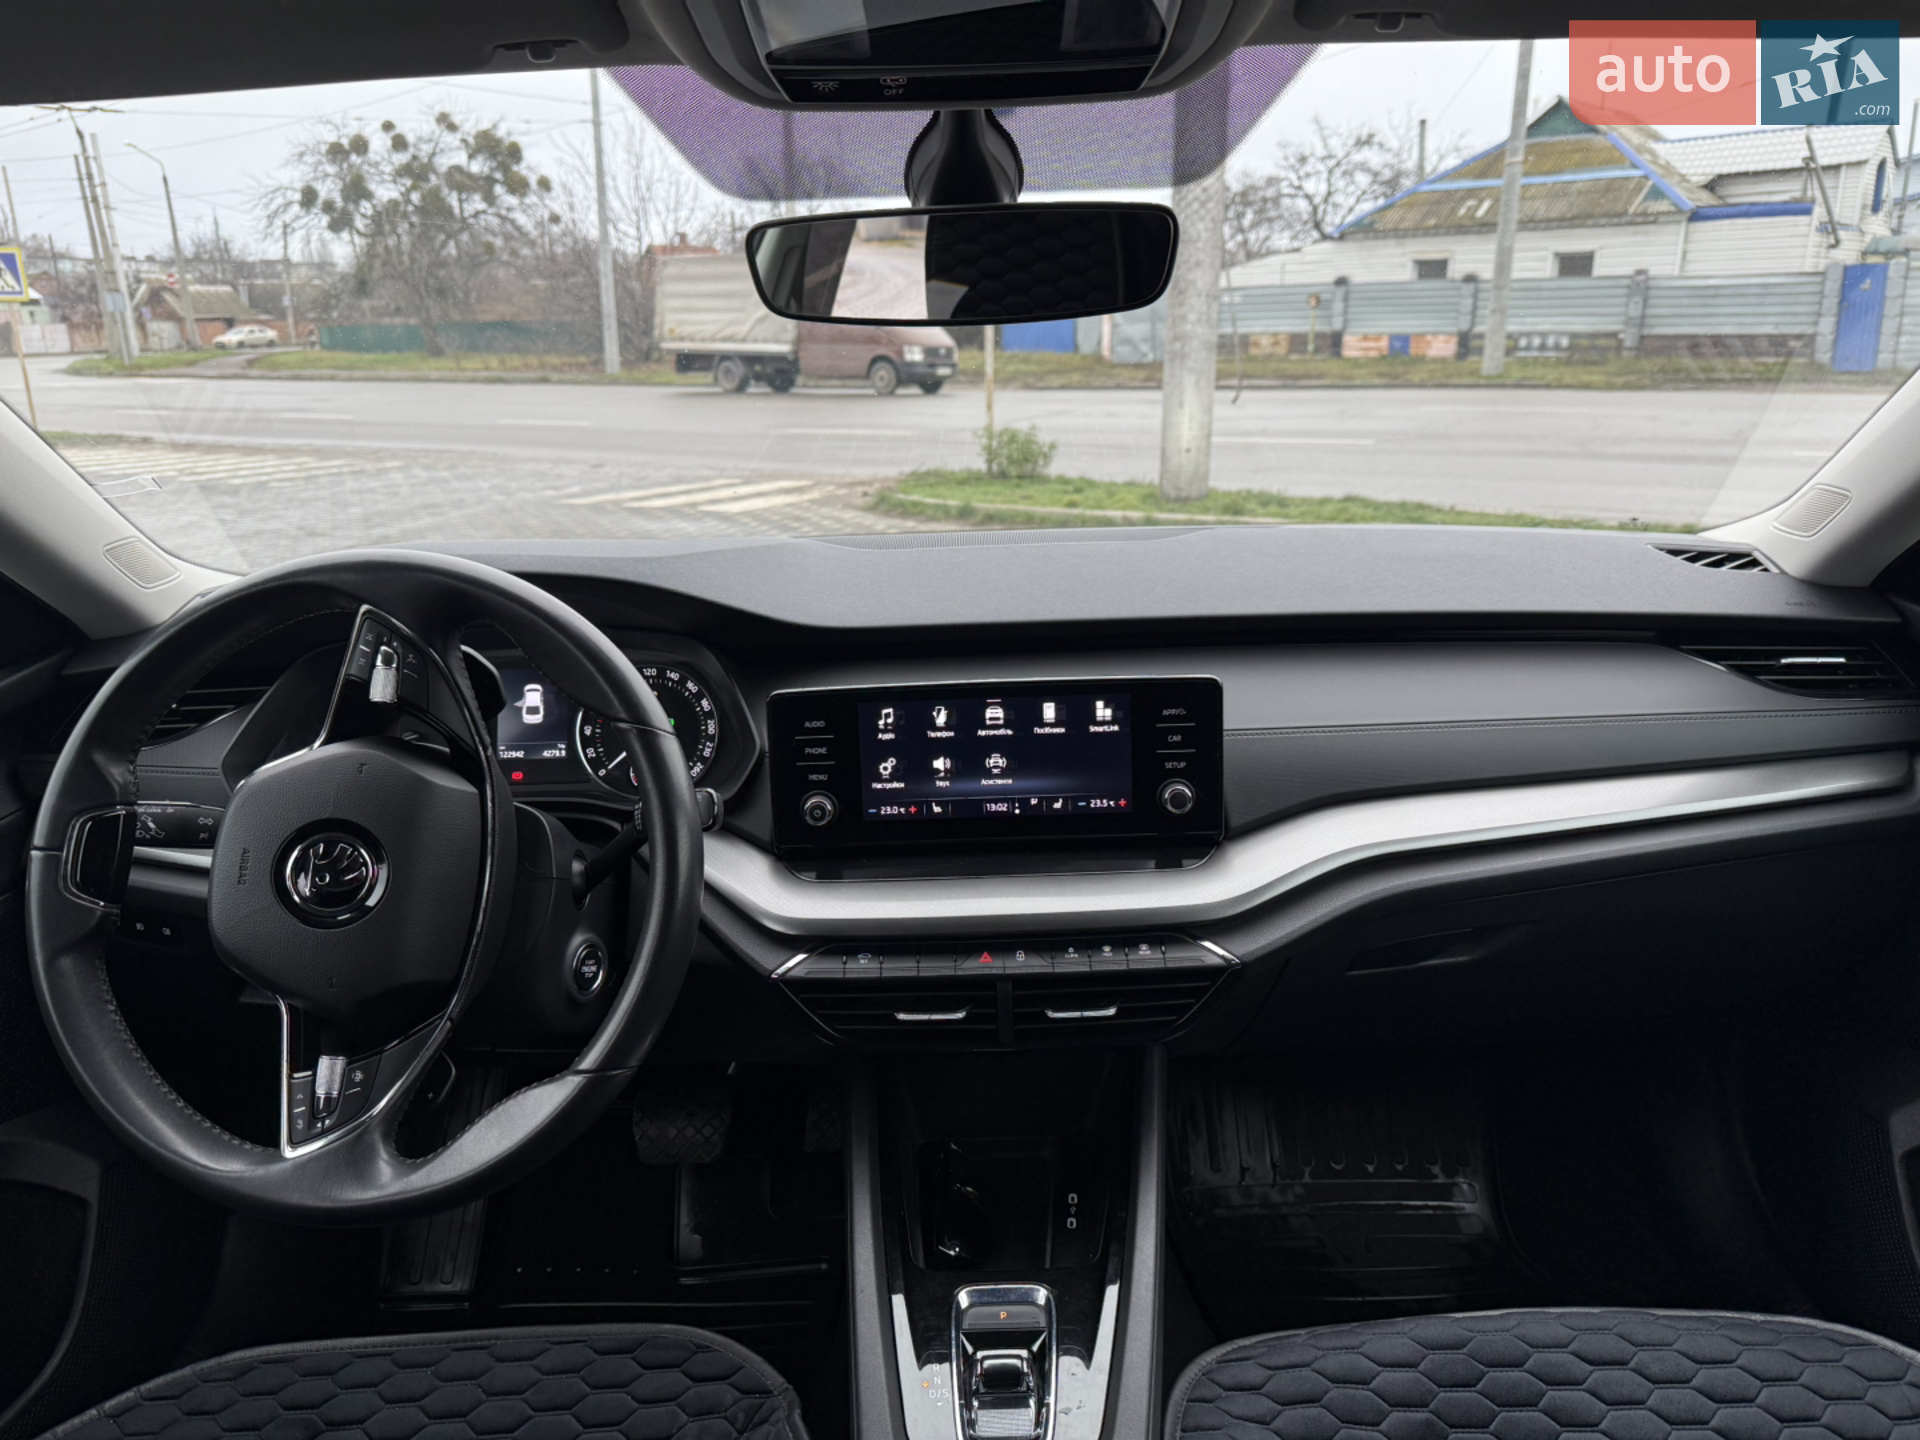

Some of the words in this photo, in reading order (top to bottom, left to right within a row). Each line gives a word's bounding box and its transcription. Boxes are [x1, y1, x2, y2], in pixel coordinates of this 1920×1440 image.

[883, 88, 905, 96] OFF
[642, 668, 657, 676] 120
[666, 670, 680, 681] 140
[686, 680, 698, 693] 160
[700, 698, 711, 712] 180
[707, 719, 716, 735] 200
[804, 720, 826, 728] AUDIO
[1088, 724, 1120, 733] SmartLink
[583, 725, 592, 736] 40
[926, 730, 955, 739] Телефон
[585, 747, 597, 759] 20
[703, 742, 714, 757] 230
[804, 746, 828, 755] PHONE
[690, 761, 704, 777] 260
[1164, 761, 1187, 769] SETUP
[598, 768, 606, 776] 0
[808, 773, 829, 781] MENU
[986, 803, 1008, 811] 13:02
[1090, 799, 1108, 808] 23.5
[880, 806, 898, 814] 23.0
[237, 847, 250, 886] AIRBAG
[1000, 1311, 1008, 1320] P
[934, 1376, 941, 1385] N
